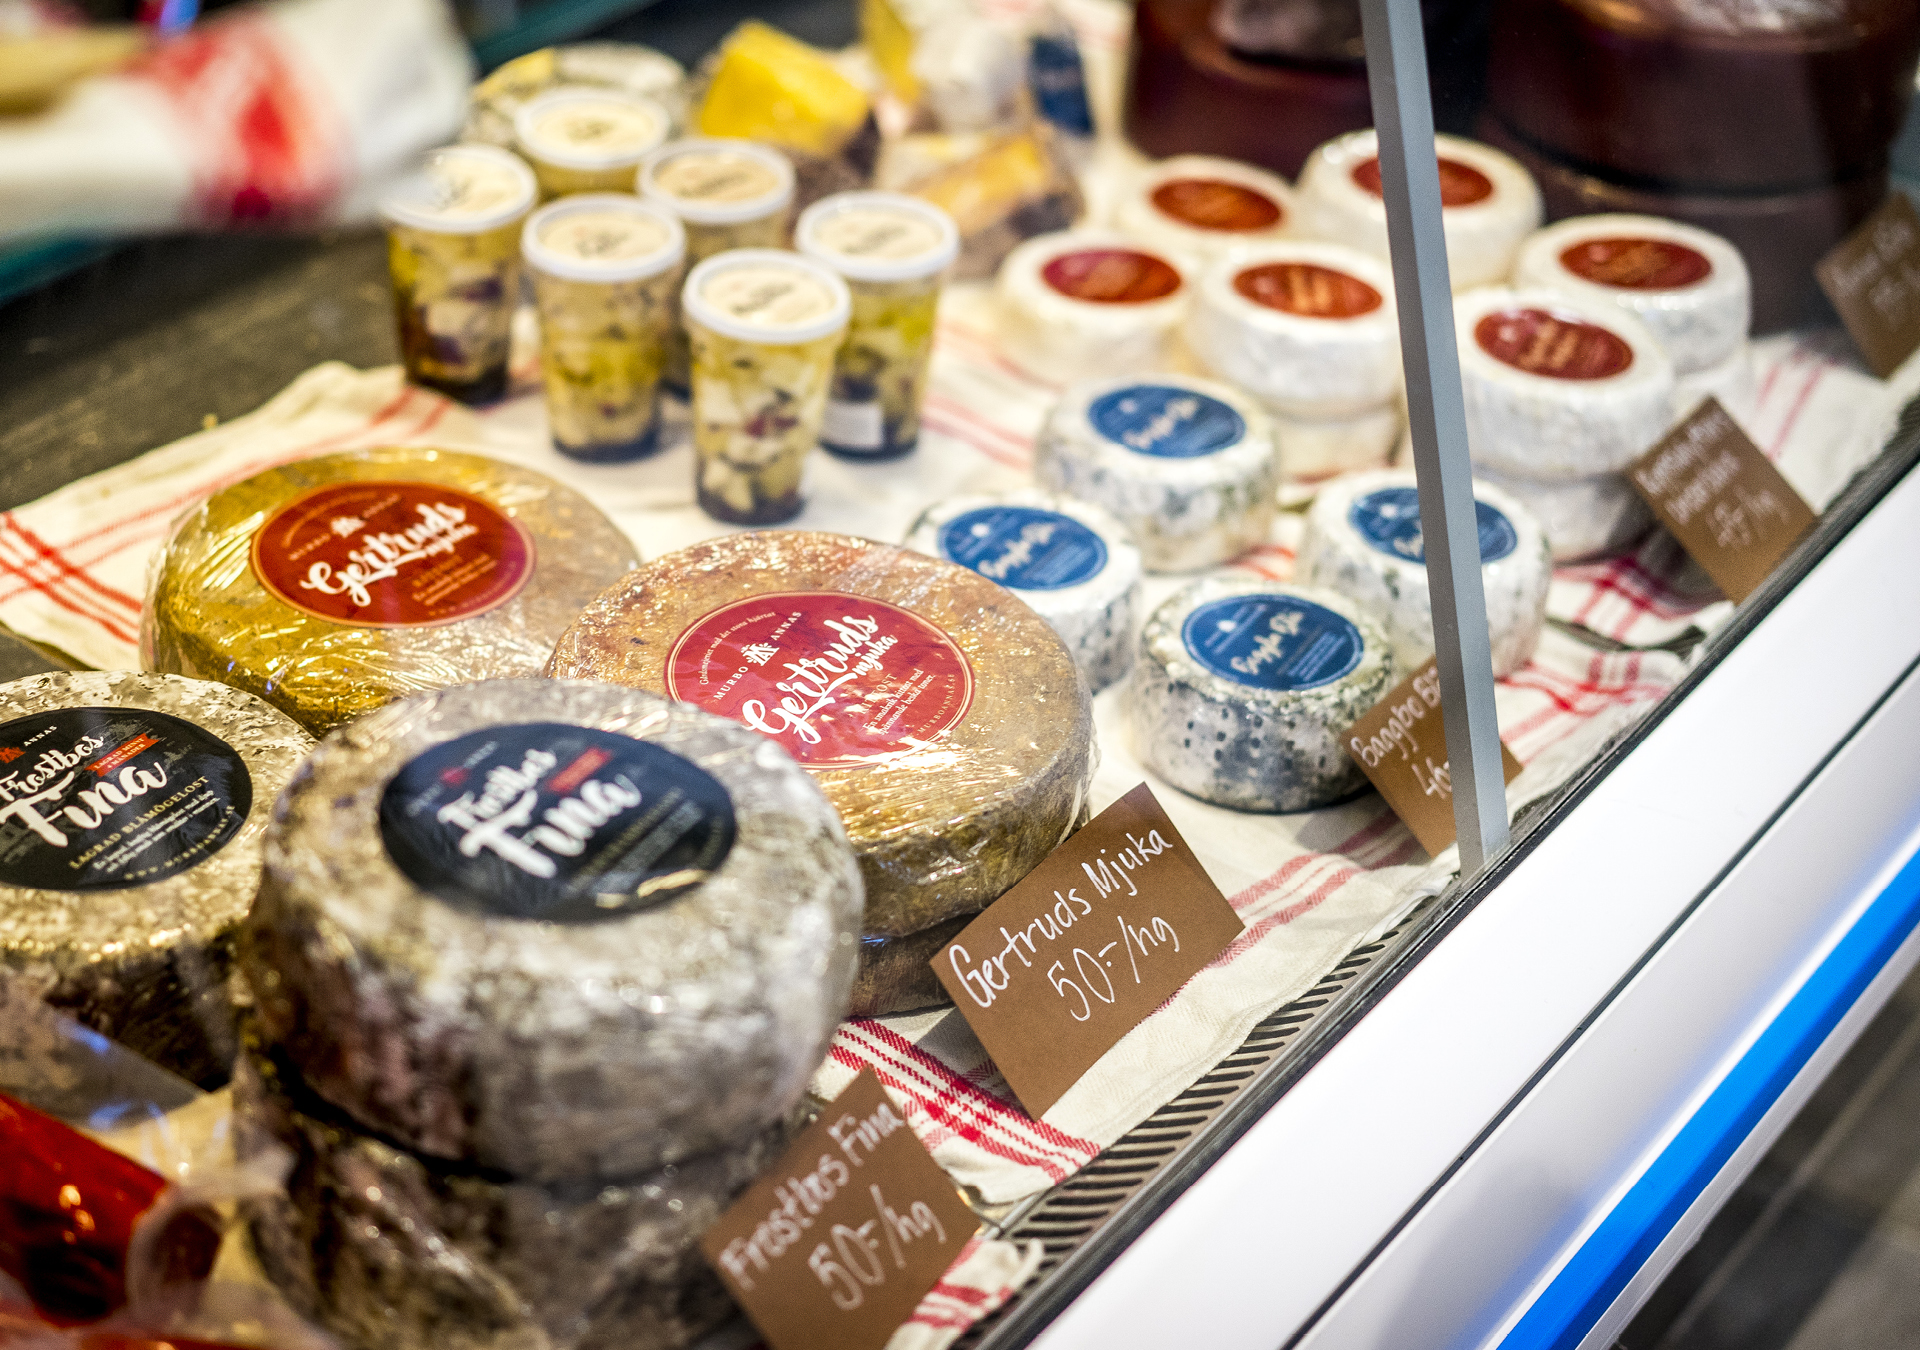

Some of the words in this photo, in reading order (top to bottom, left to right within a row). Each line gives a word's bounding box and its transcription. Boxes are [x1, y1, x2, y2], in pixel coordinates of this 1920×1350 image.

[713, 666, 748, 700] MURBO
[770, 611, 802, 641] ANNAS
[741, 614, 878, 744] Gertruds
[852, 634, 898, 676] mjuka
[909, 668, 924, 681] med
[0, 735, 104, 801] Frostbos
[24, 725, 57, 747] ANNAS
[0, 762, 168, 848] Fina
[121, 775, 210, 834] BLÅMÖGELOST
[949, 888, 1092, 1008] Gertruds
[1081, 829, 1174, 899] Mjuka
[827, 1102, 906, 1167] Fina
